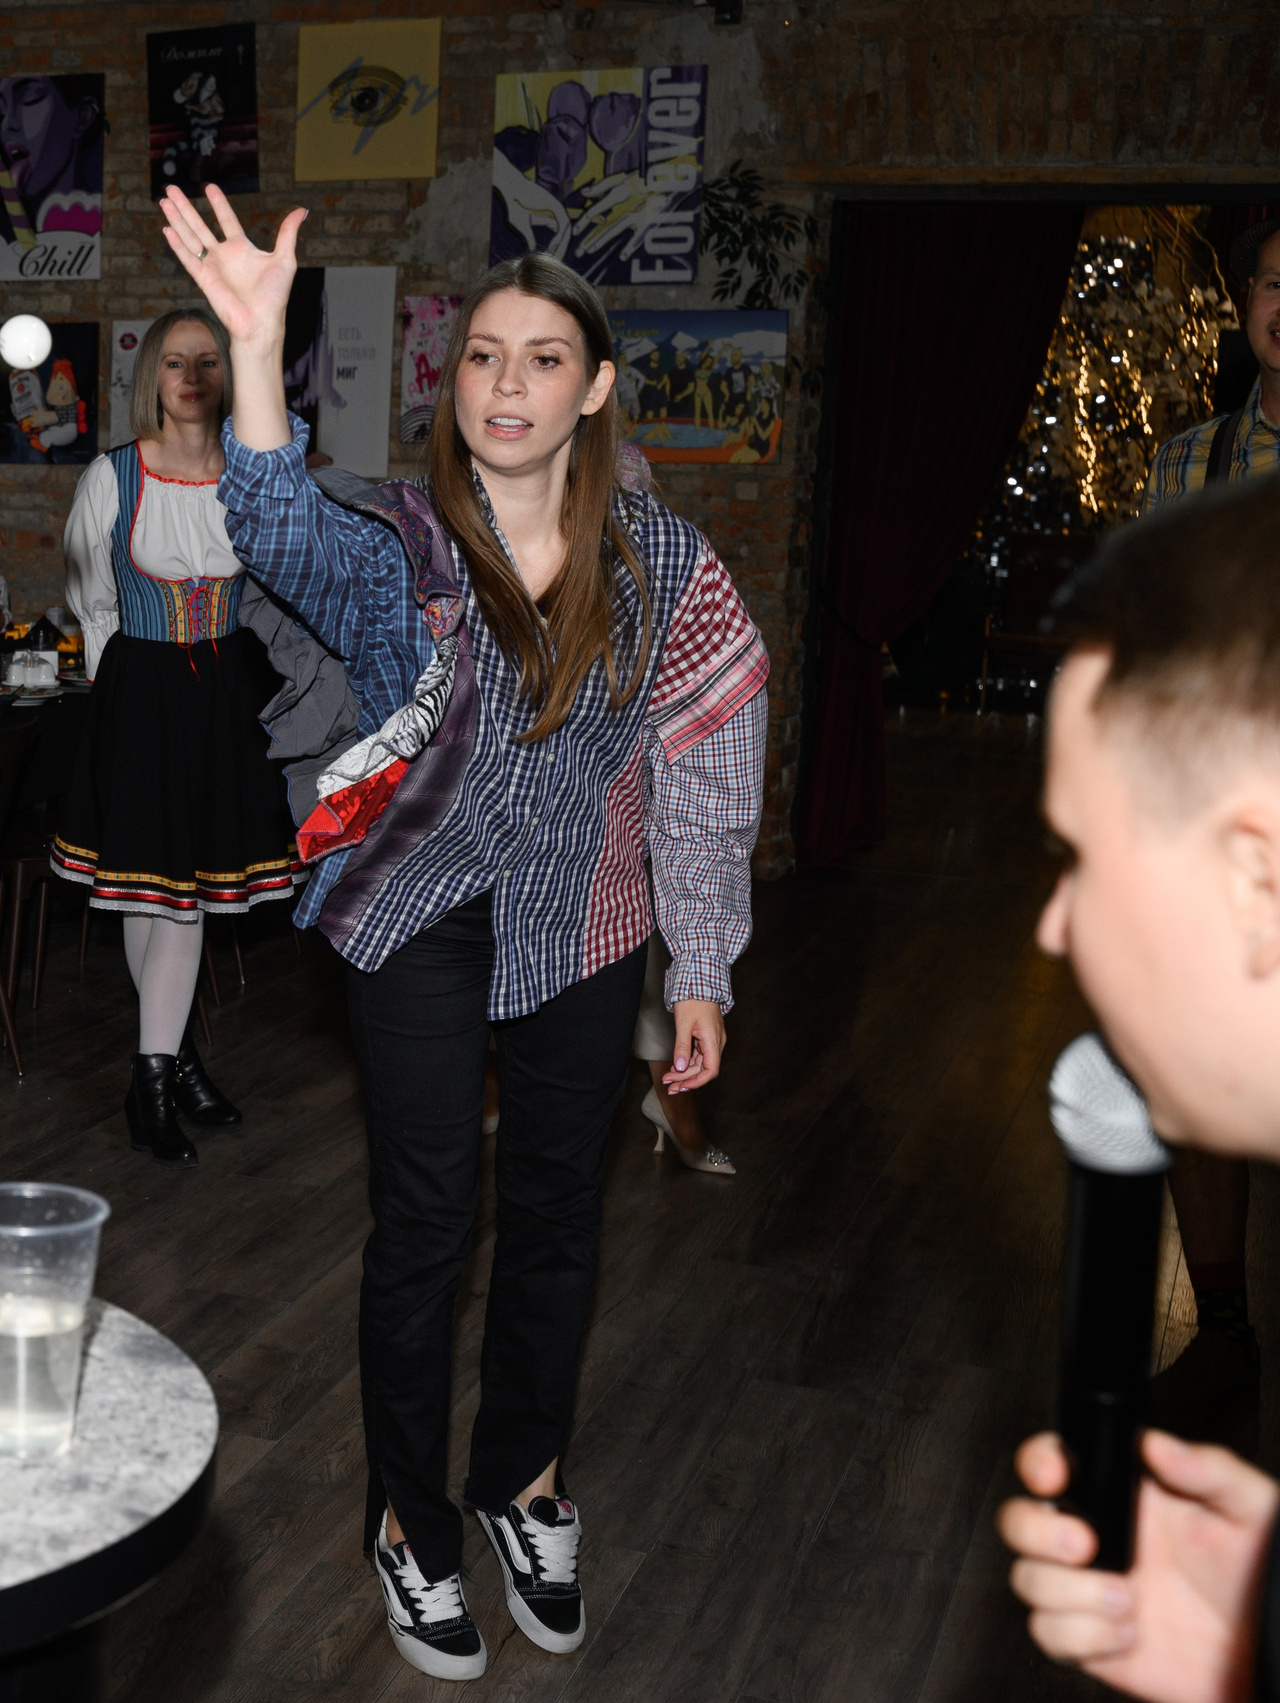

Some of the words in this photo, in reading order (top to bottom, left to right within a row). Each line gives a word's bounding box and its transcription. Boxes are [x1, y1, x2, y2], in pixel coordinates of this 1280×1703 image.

[18, 245, 96, 277] Chill
[337, 327, 363, 341] ЕСТЬ
[337, 346, 376, 361] ТОЛЬКО
[336, 366, 359, 380] МИГ
